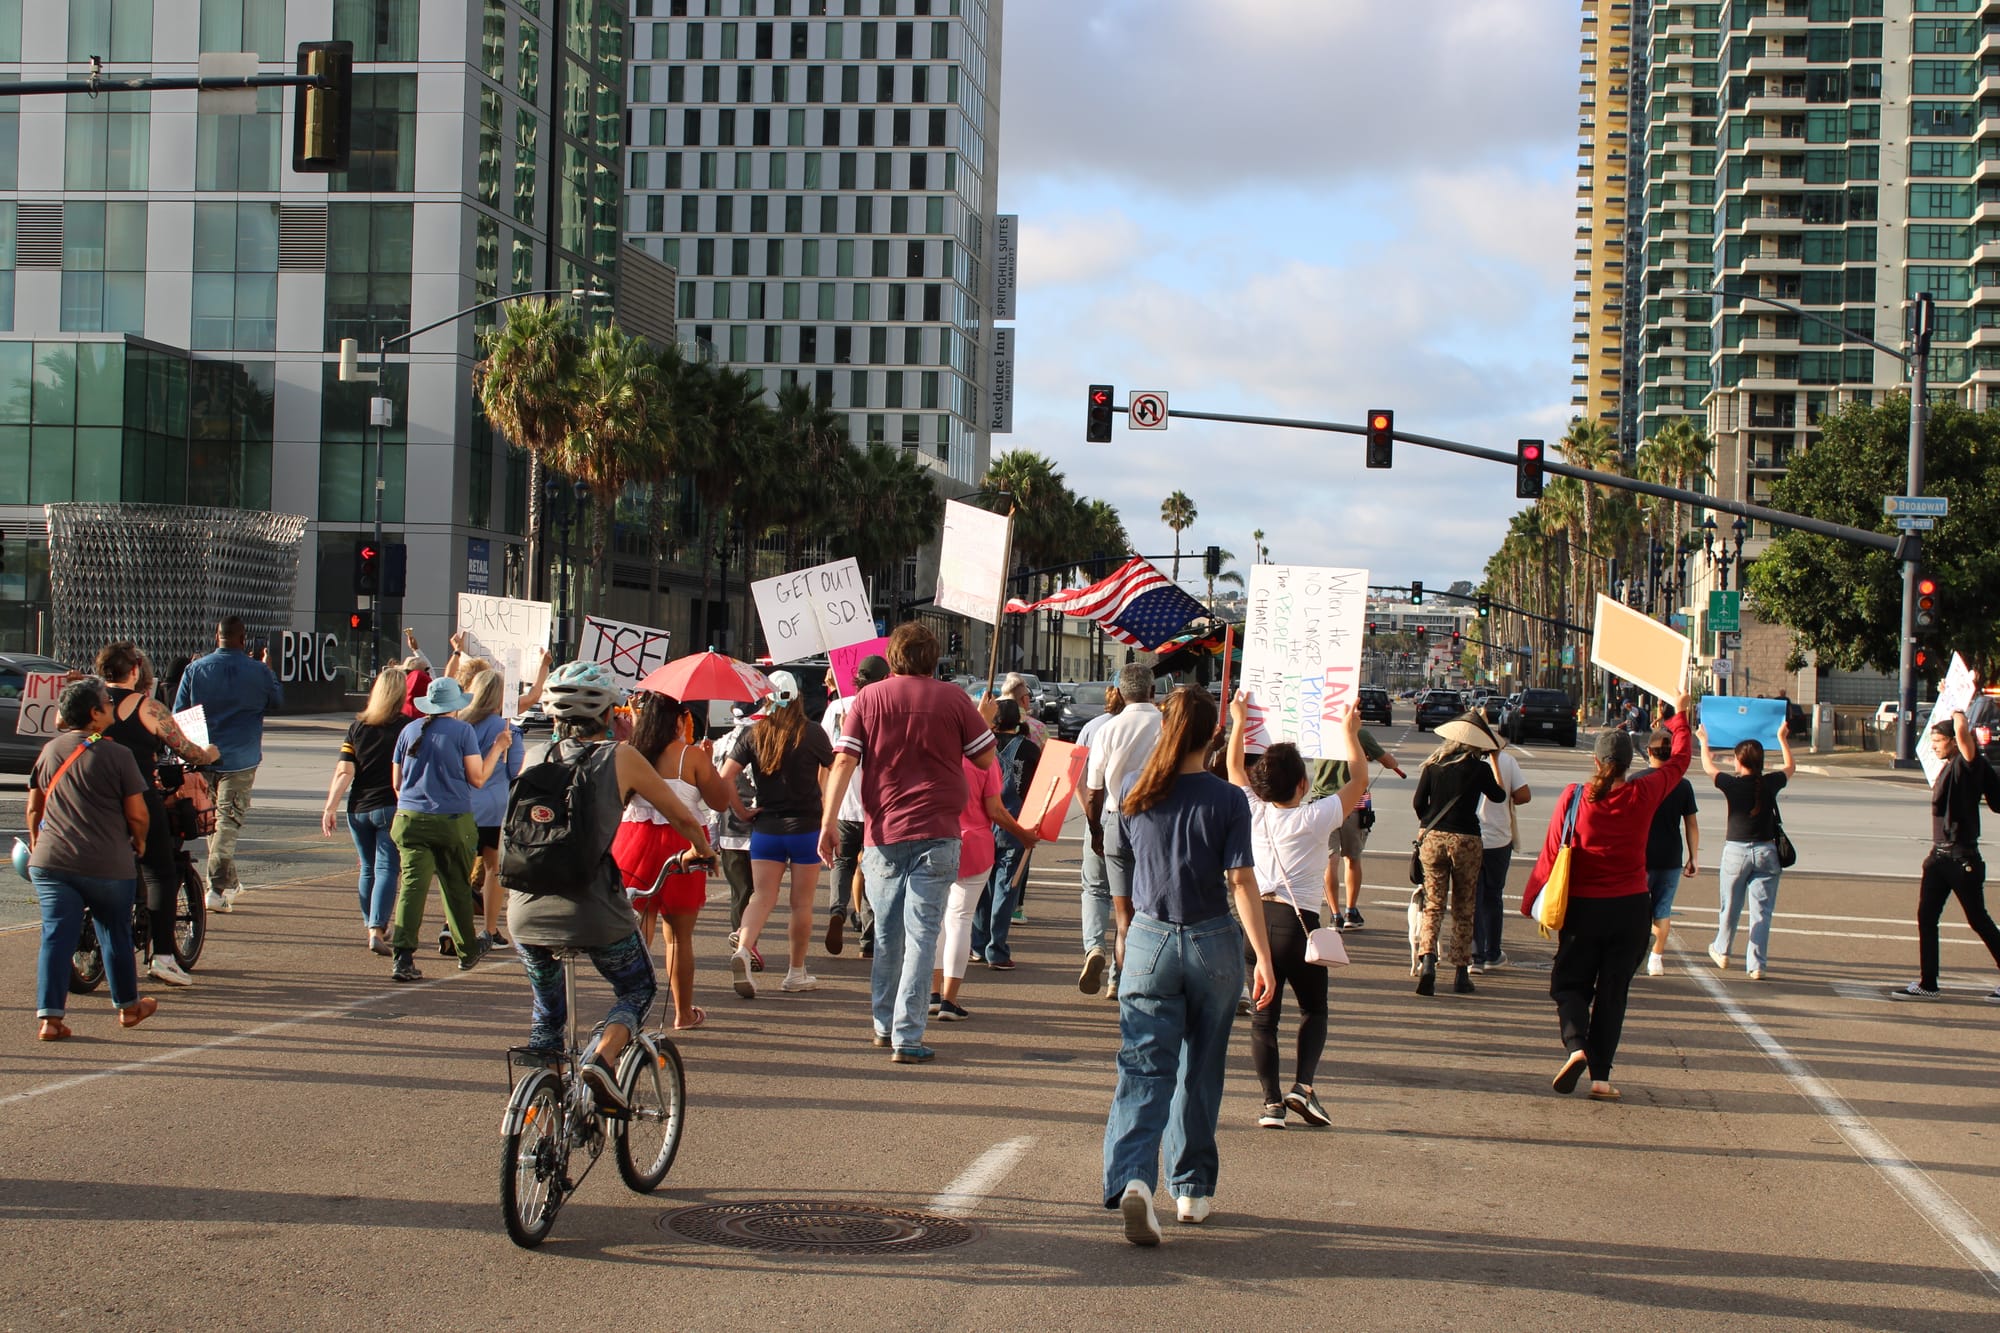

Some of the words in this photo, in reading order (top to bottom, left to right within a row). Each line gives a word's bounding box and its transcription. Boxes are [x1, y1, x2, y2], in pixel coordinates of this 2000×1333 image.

[999, 217, 1009, 252] SUITES
[997, 253, 1007, 316] SPRINGHILL
[994, 331, 1006, 356] Inn
[992, 359, 1006, 429] Residence
[1898, 501, 1944, 512] BROADWAY
[468, 558, 488, 574] RETAIL
[776, 571, 813, 603] GET
[821, 566, 854, 592] OUT
[1277, 568, 1290, 590] The
[1305, 572, 1322, 596] NO
[1327, 572, 1361, 617] When
[459, 597, 550, 635] BARRETT
[778, 612, 800, 639] OF
[1251, 588, 1270, 649] CHANGE
[1272, 592, 1294, 659] PEOPLE
[281, 630, 338, 681] BRIC
[1287, 639, 1303, 666] the
[1301, 607, 1322, 671] LONGER
[1328, 627, 1352, 649] the
[1249, 666, 1265, 697] THE
[1267, 672, 1283, 712] MUST
[1321, 666, 1354, 723] LAW
[1282, 672, 1303, 745] PEOPLE
